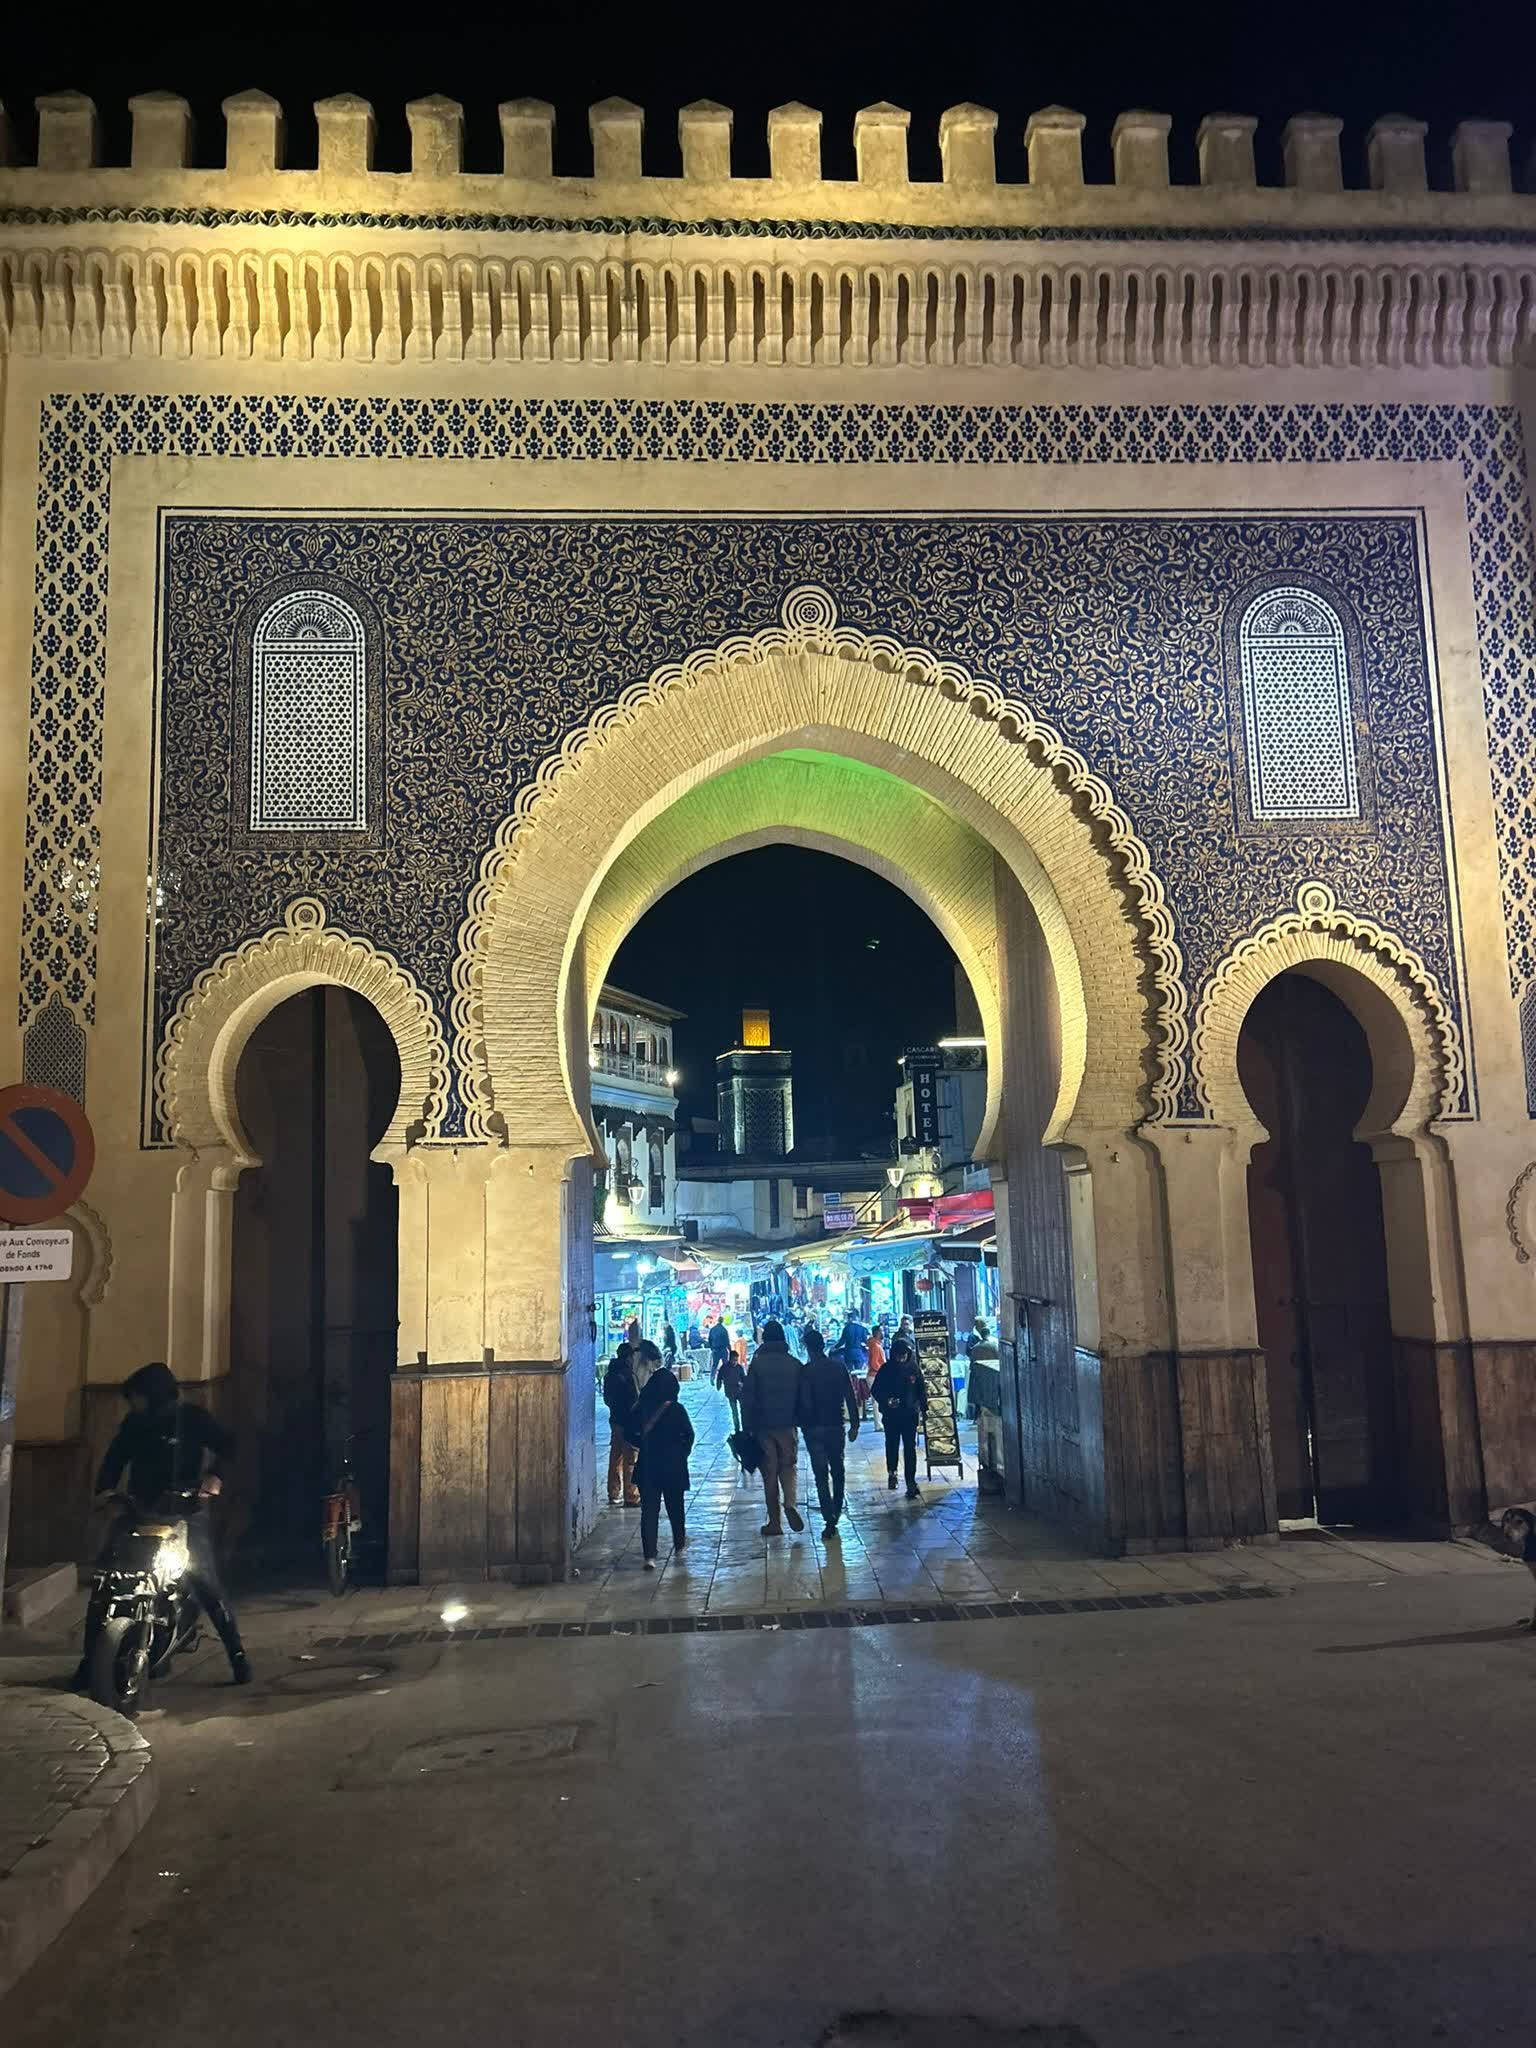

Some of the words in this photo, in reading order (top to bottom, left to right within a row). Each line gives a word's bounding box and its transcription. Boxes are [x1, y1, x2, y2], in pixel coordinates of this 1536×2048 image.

[920, 1073, 932, 1143] HOTEL
[9, 1238, 24, 1246] Aux
[26, 1238, 70, 1247] Convoyeurs
[6, 1250, 15, 1259] de
[17, 1250, 41, 1258] Fonds
